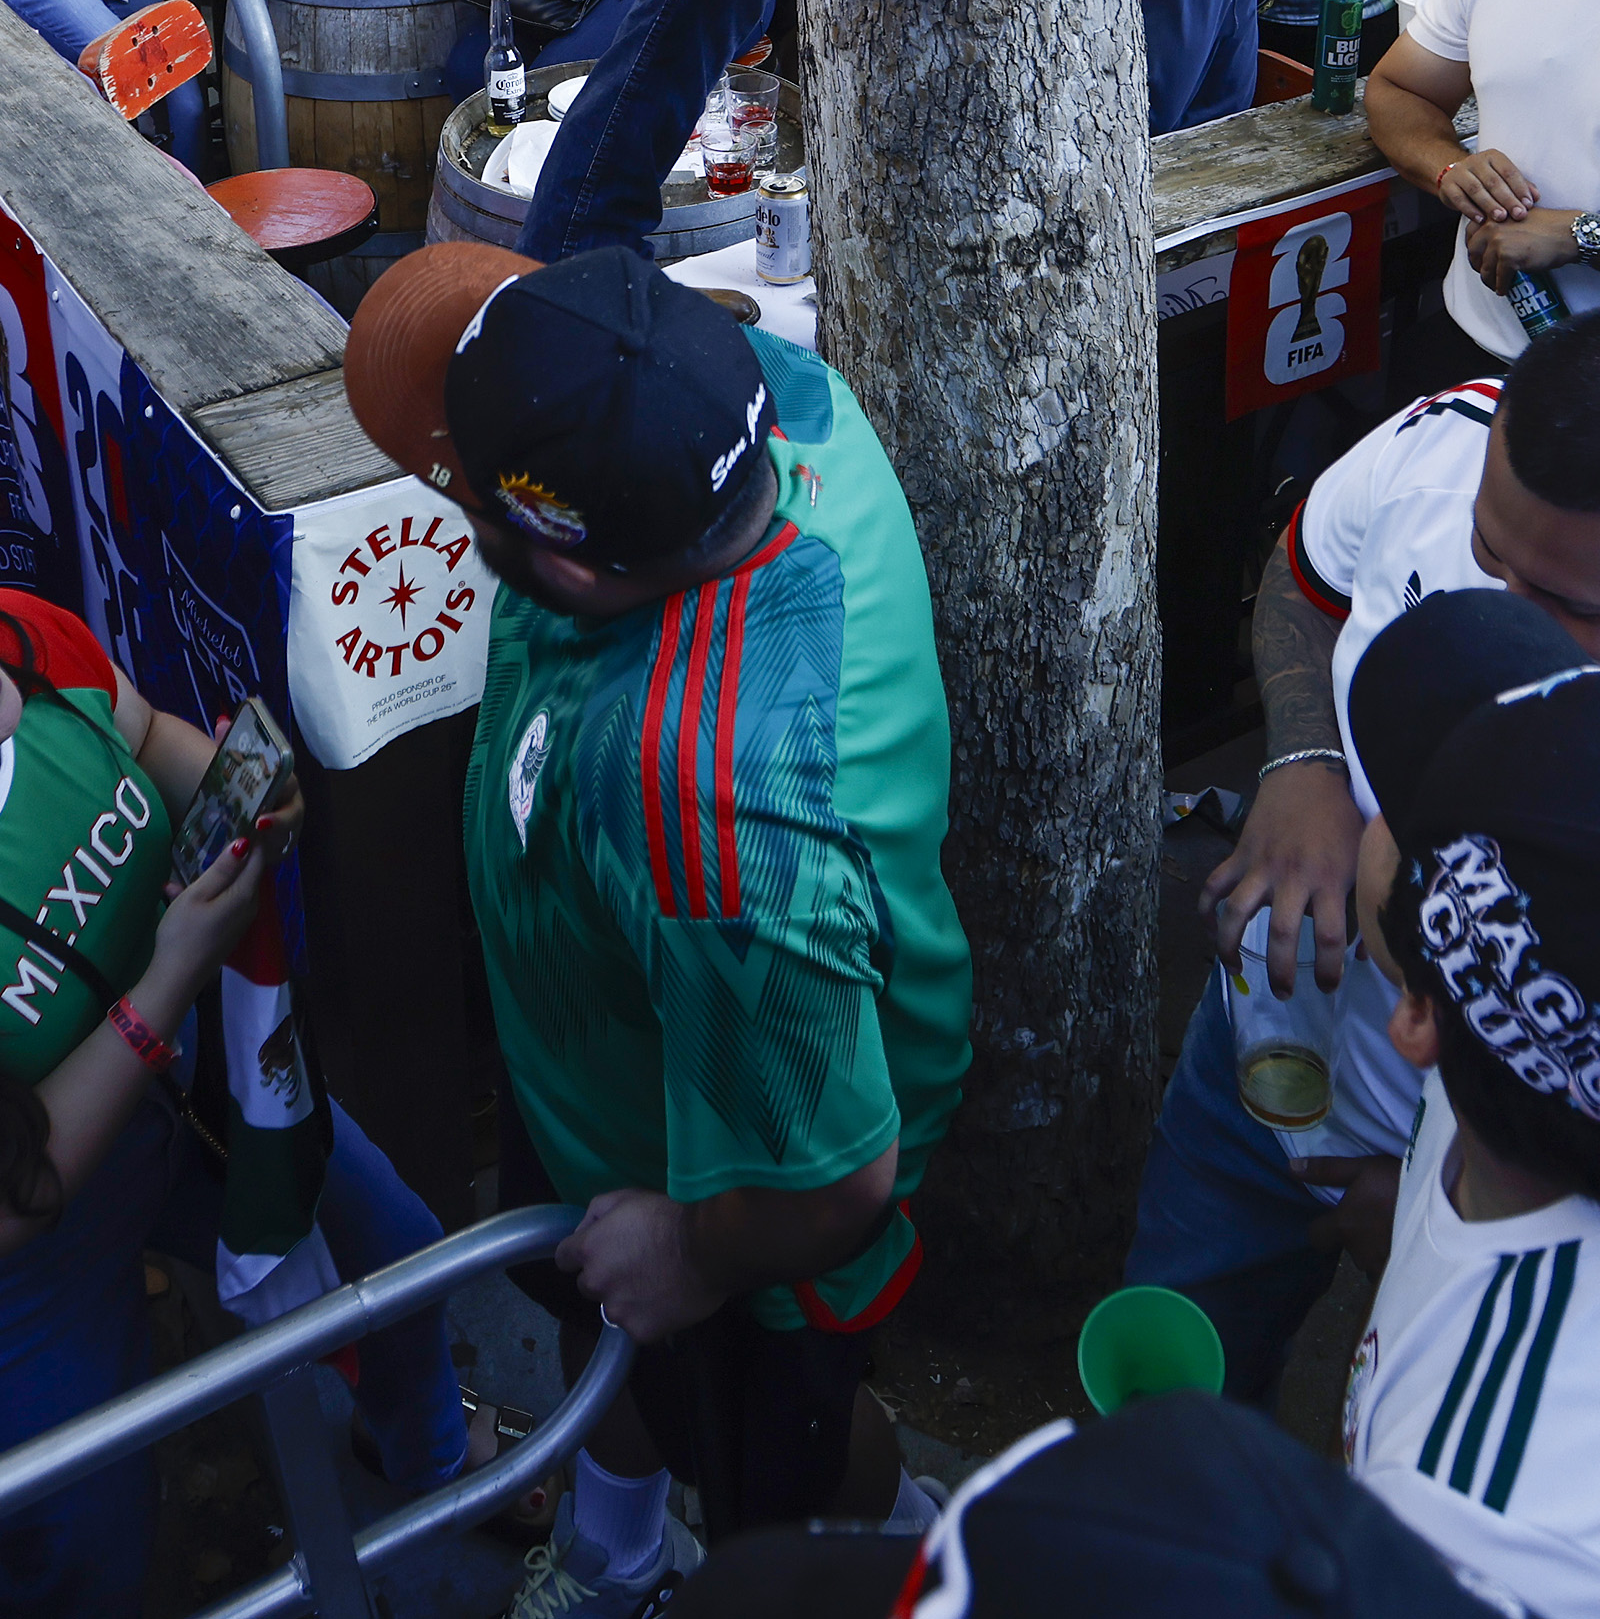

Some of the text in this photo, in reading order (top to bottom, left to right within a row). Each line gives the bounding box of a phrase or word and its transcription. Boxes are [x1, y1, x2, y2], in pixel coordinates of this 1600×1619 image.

[1327, 51, 1359, 66] LIG
[1335, 37, 1360, 54] BU
[1510, 282, 1536, 303] UD
[1512, 289, 1552, 318] GHT
[1287, 341, 1324, 368] FIFA
[427, 462, 452, 488] 18
[709, 435, 749, 494] San
[331, 516, 471, 607] STELLA
[169, 586, 249, 704] ULTR
[179, 587, 243, 669] Michelob
[335, 586, 476, 679] ARTOIS
[366, 714, 379, 727] THE
[378, 706, 393, 719] FIFA
[393, 692, 422, 711] WORLD
[422, 687, 440, 699] CUP
[371, 673, 447, 713] PROUD SPONSOR OF
[0, 777, 155, 1029] MEXICO
[1418, 891, 1575, 1095] CLUB
